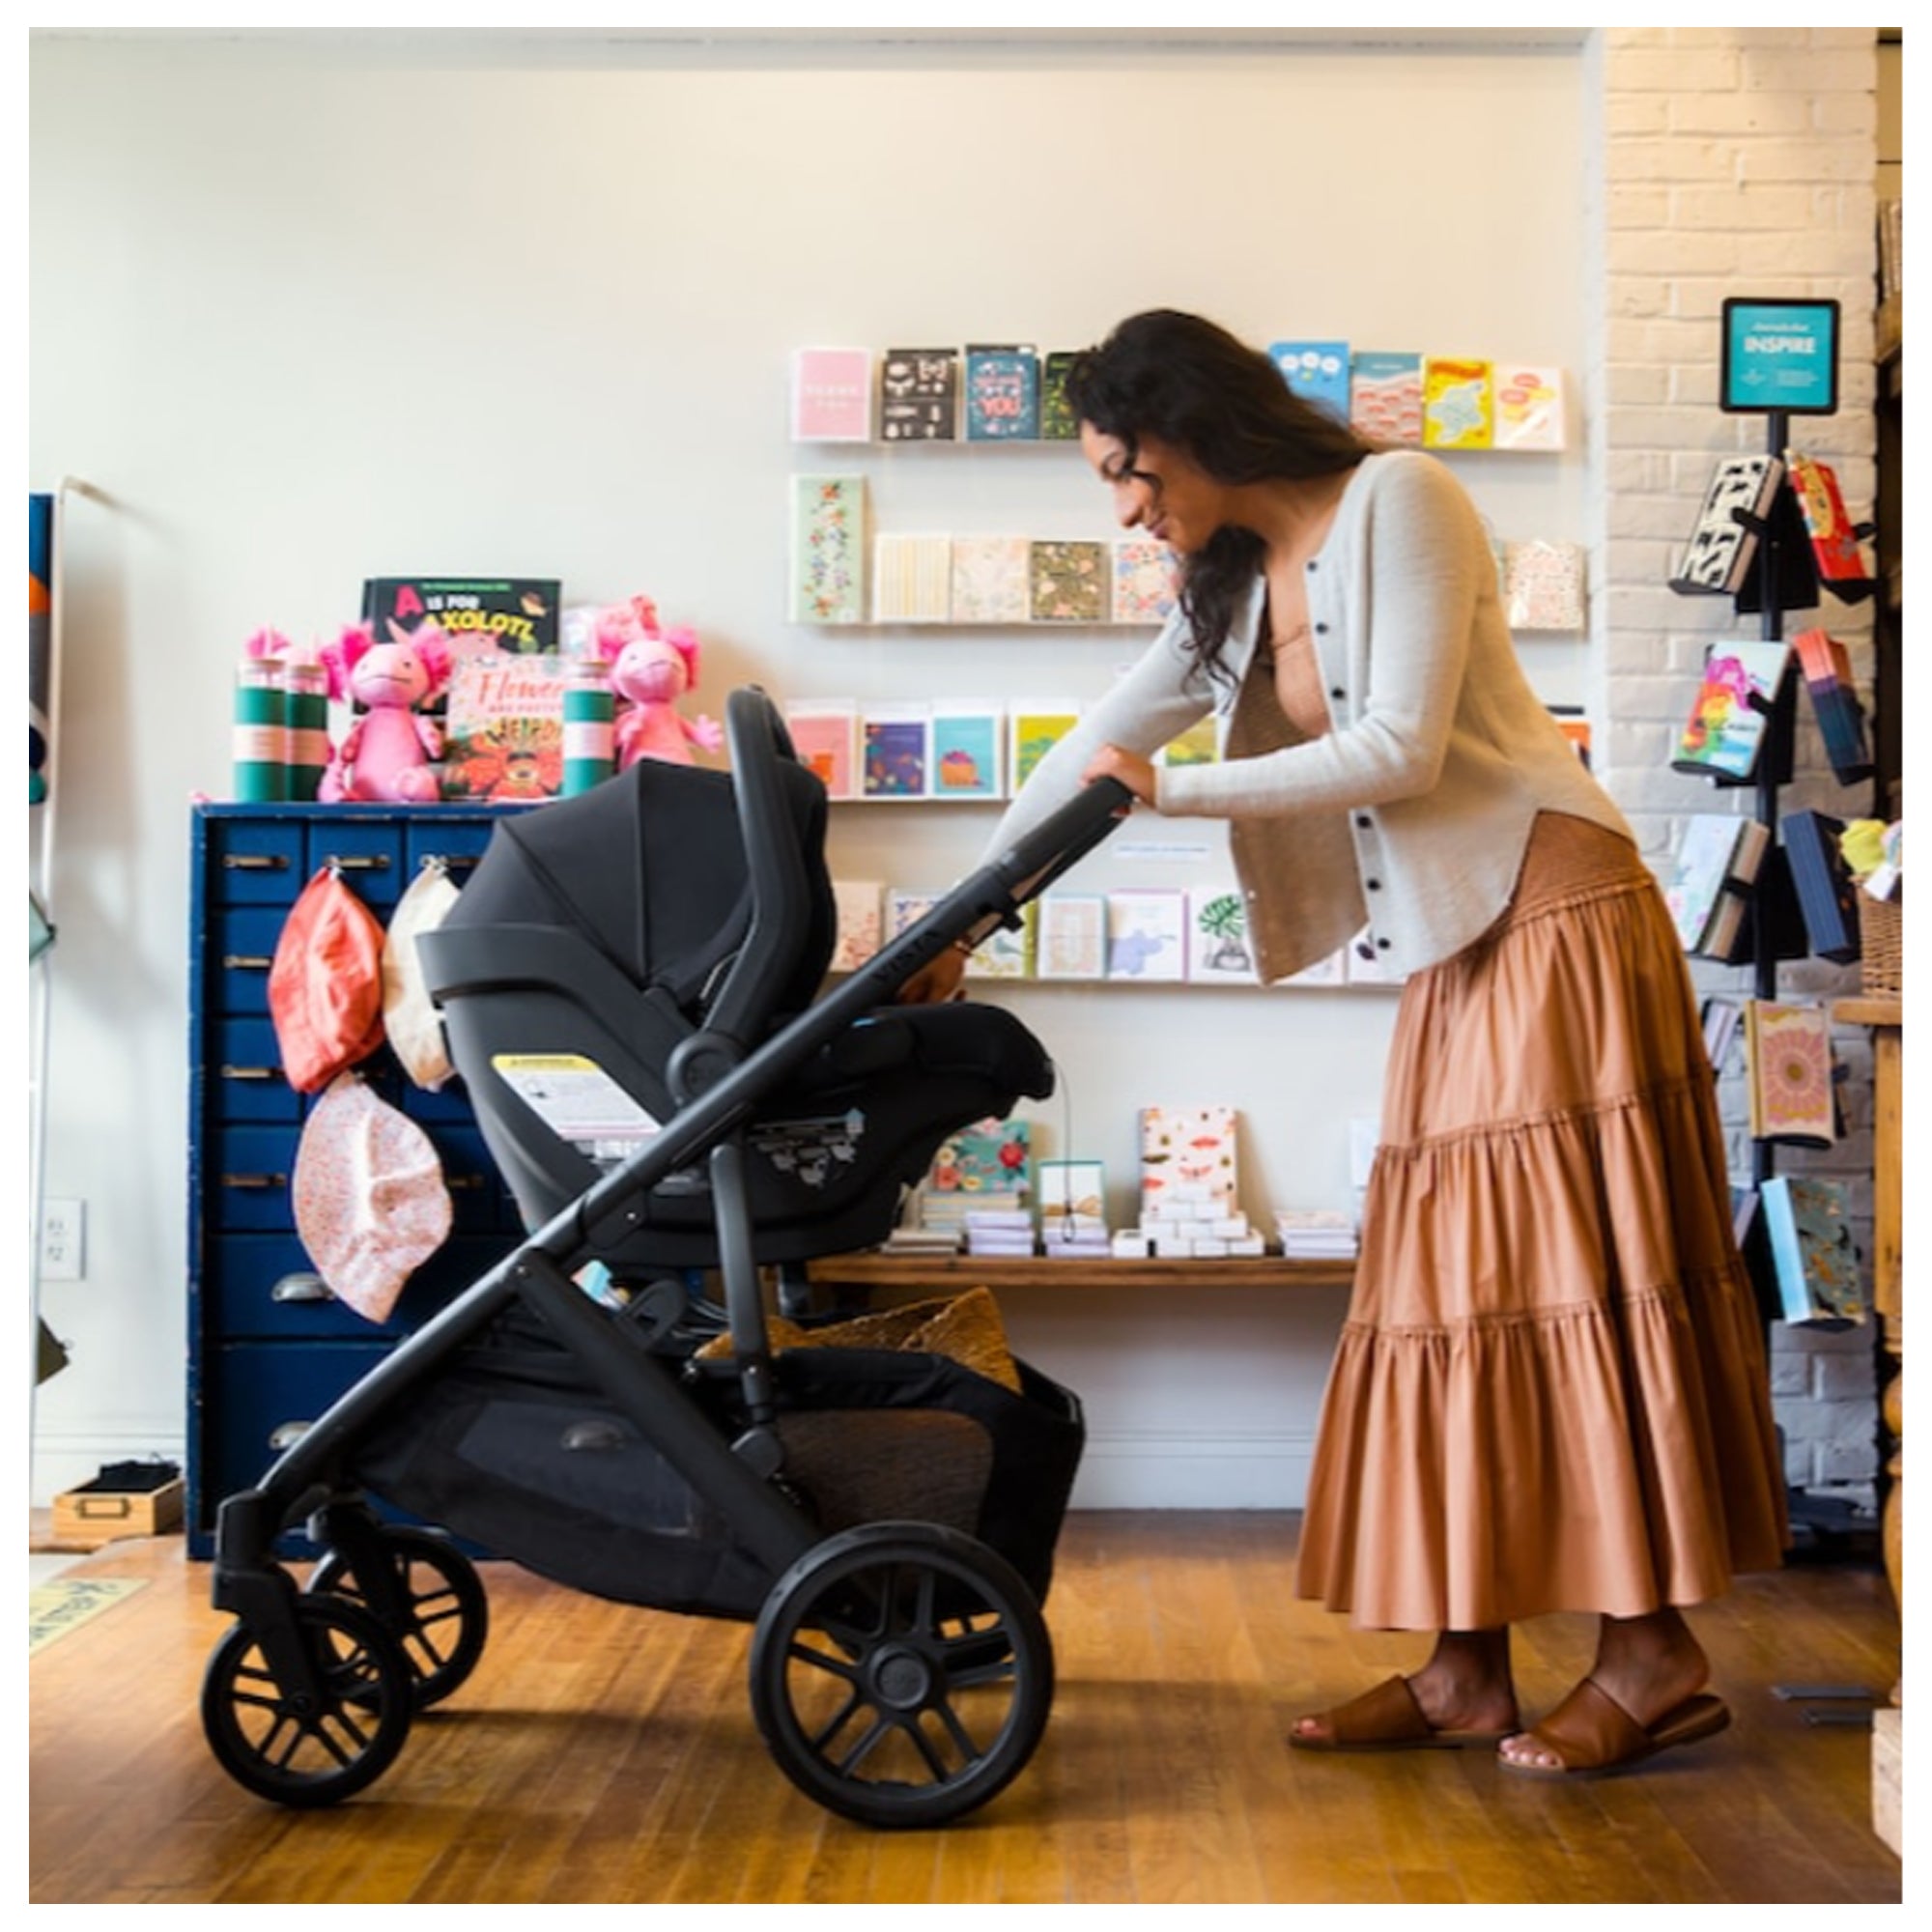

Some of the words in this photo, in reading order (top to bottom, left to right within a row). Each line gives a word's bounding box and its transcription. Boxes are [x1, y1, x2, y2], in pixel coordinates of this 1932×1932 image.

[1744, 336, 1816, 354] INSPIRE
[978, 397, 1021, 418] YOU
[394, 585, 424, 617] A
[426, 595, 443, 611] IS
[446, 593, 480, 611] FOR
